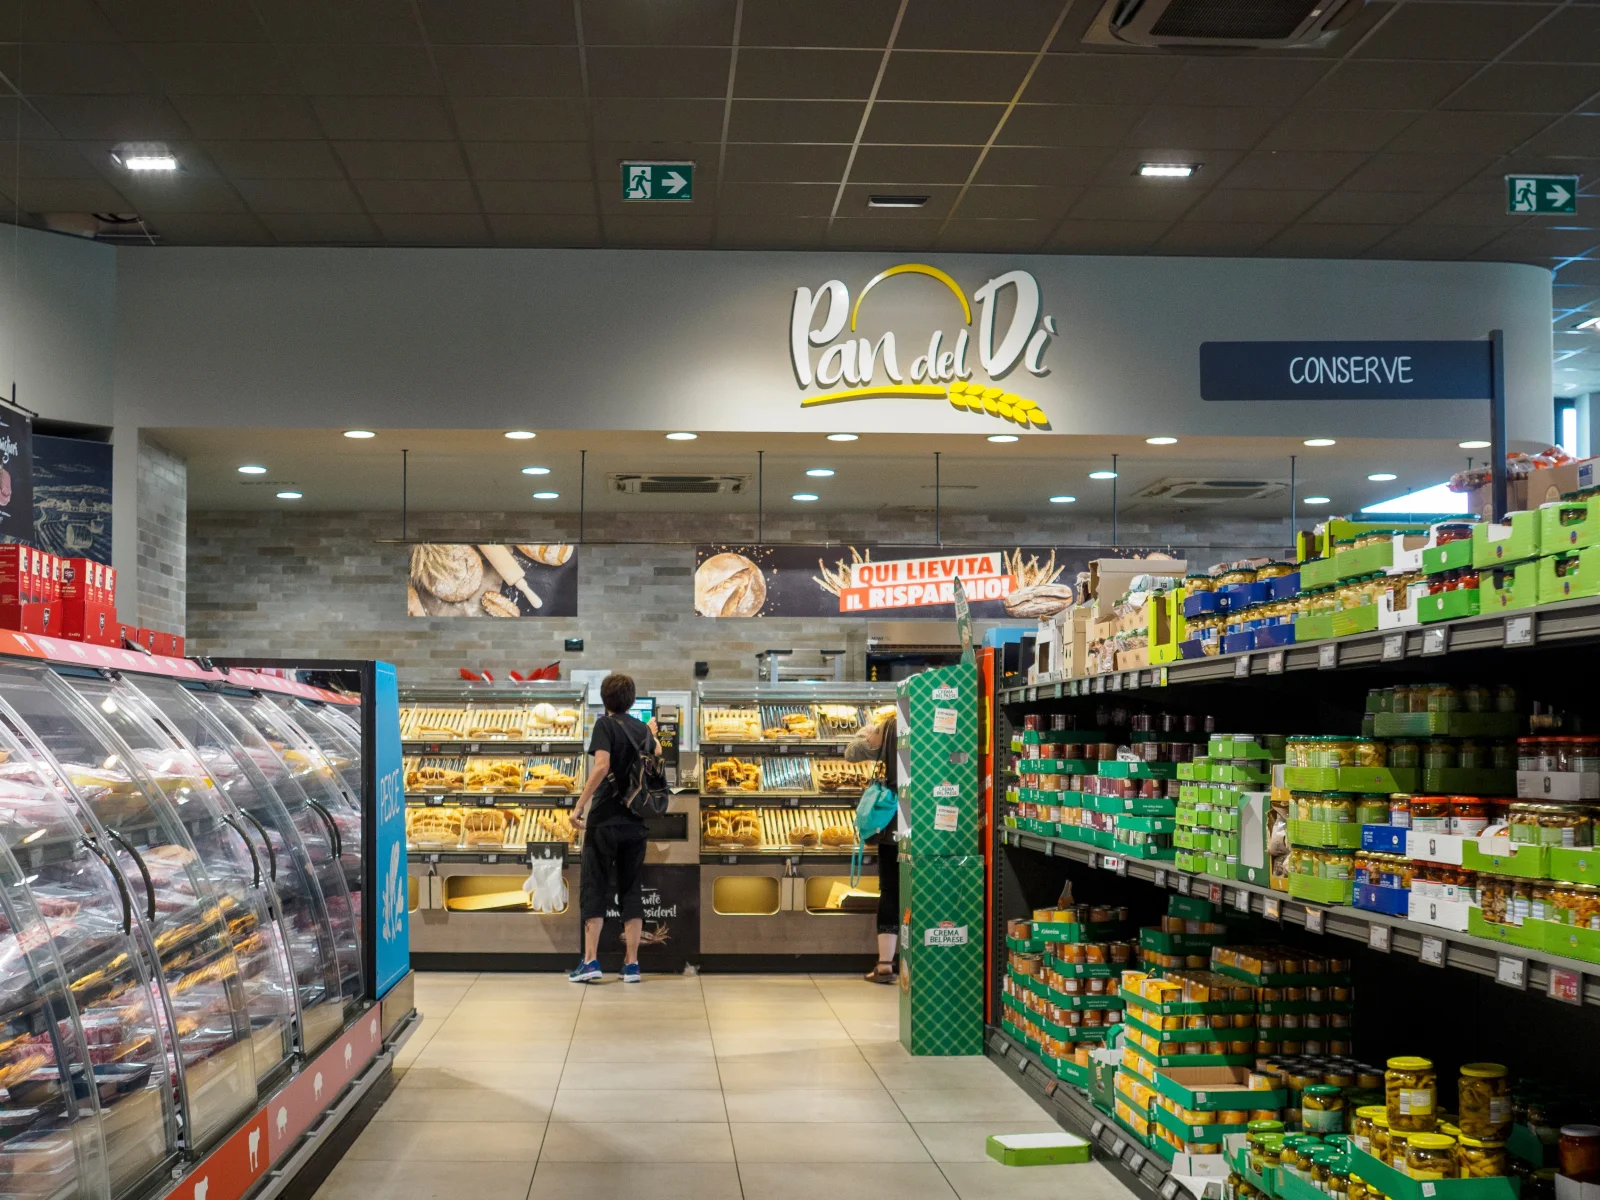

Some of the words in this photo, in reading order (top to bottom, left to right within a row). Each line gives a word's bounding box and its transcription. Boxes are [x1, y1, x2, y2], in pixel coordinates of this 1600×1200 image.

[790, 279, 903, 388] Pan
[910, 329, 972, 381] del
[1289, 356, 1414, 384] CONSERVE
[858, 563, 898, 586] QUI
[906, 556, 994, 580] LIEVITA
[846, 593, 863, 609] IL
[380, 768, 400, 826] PESCE
